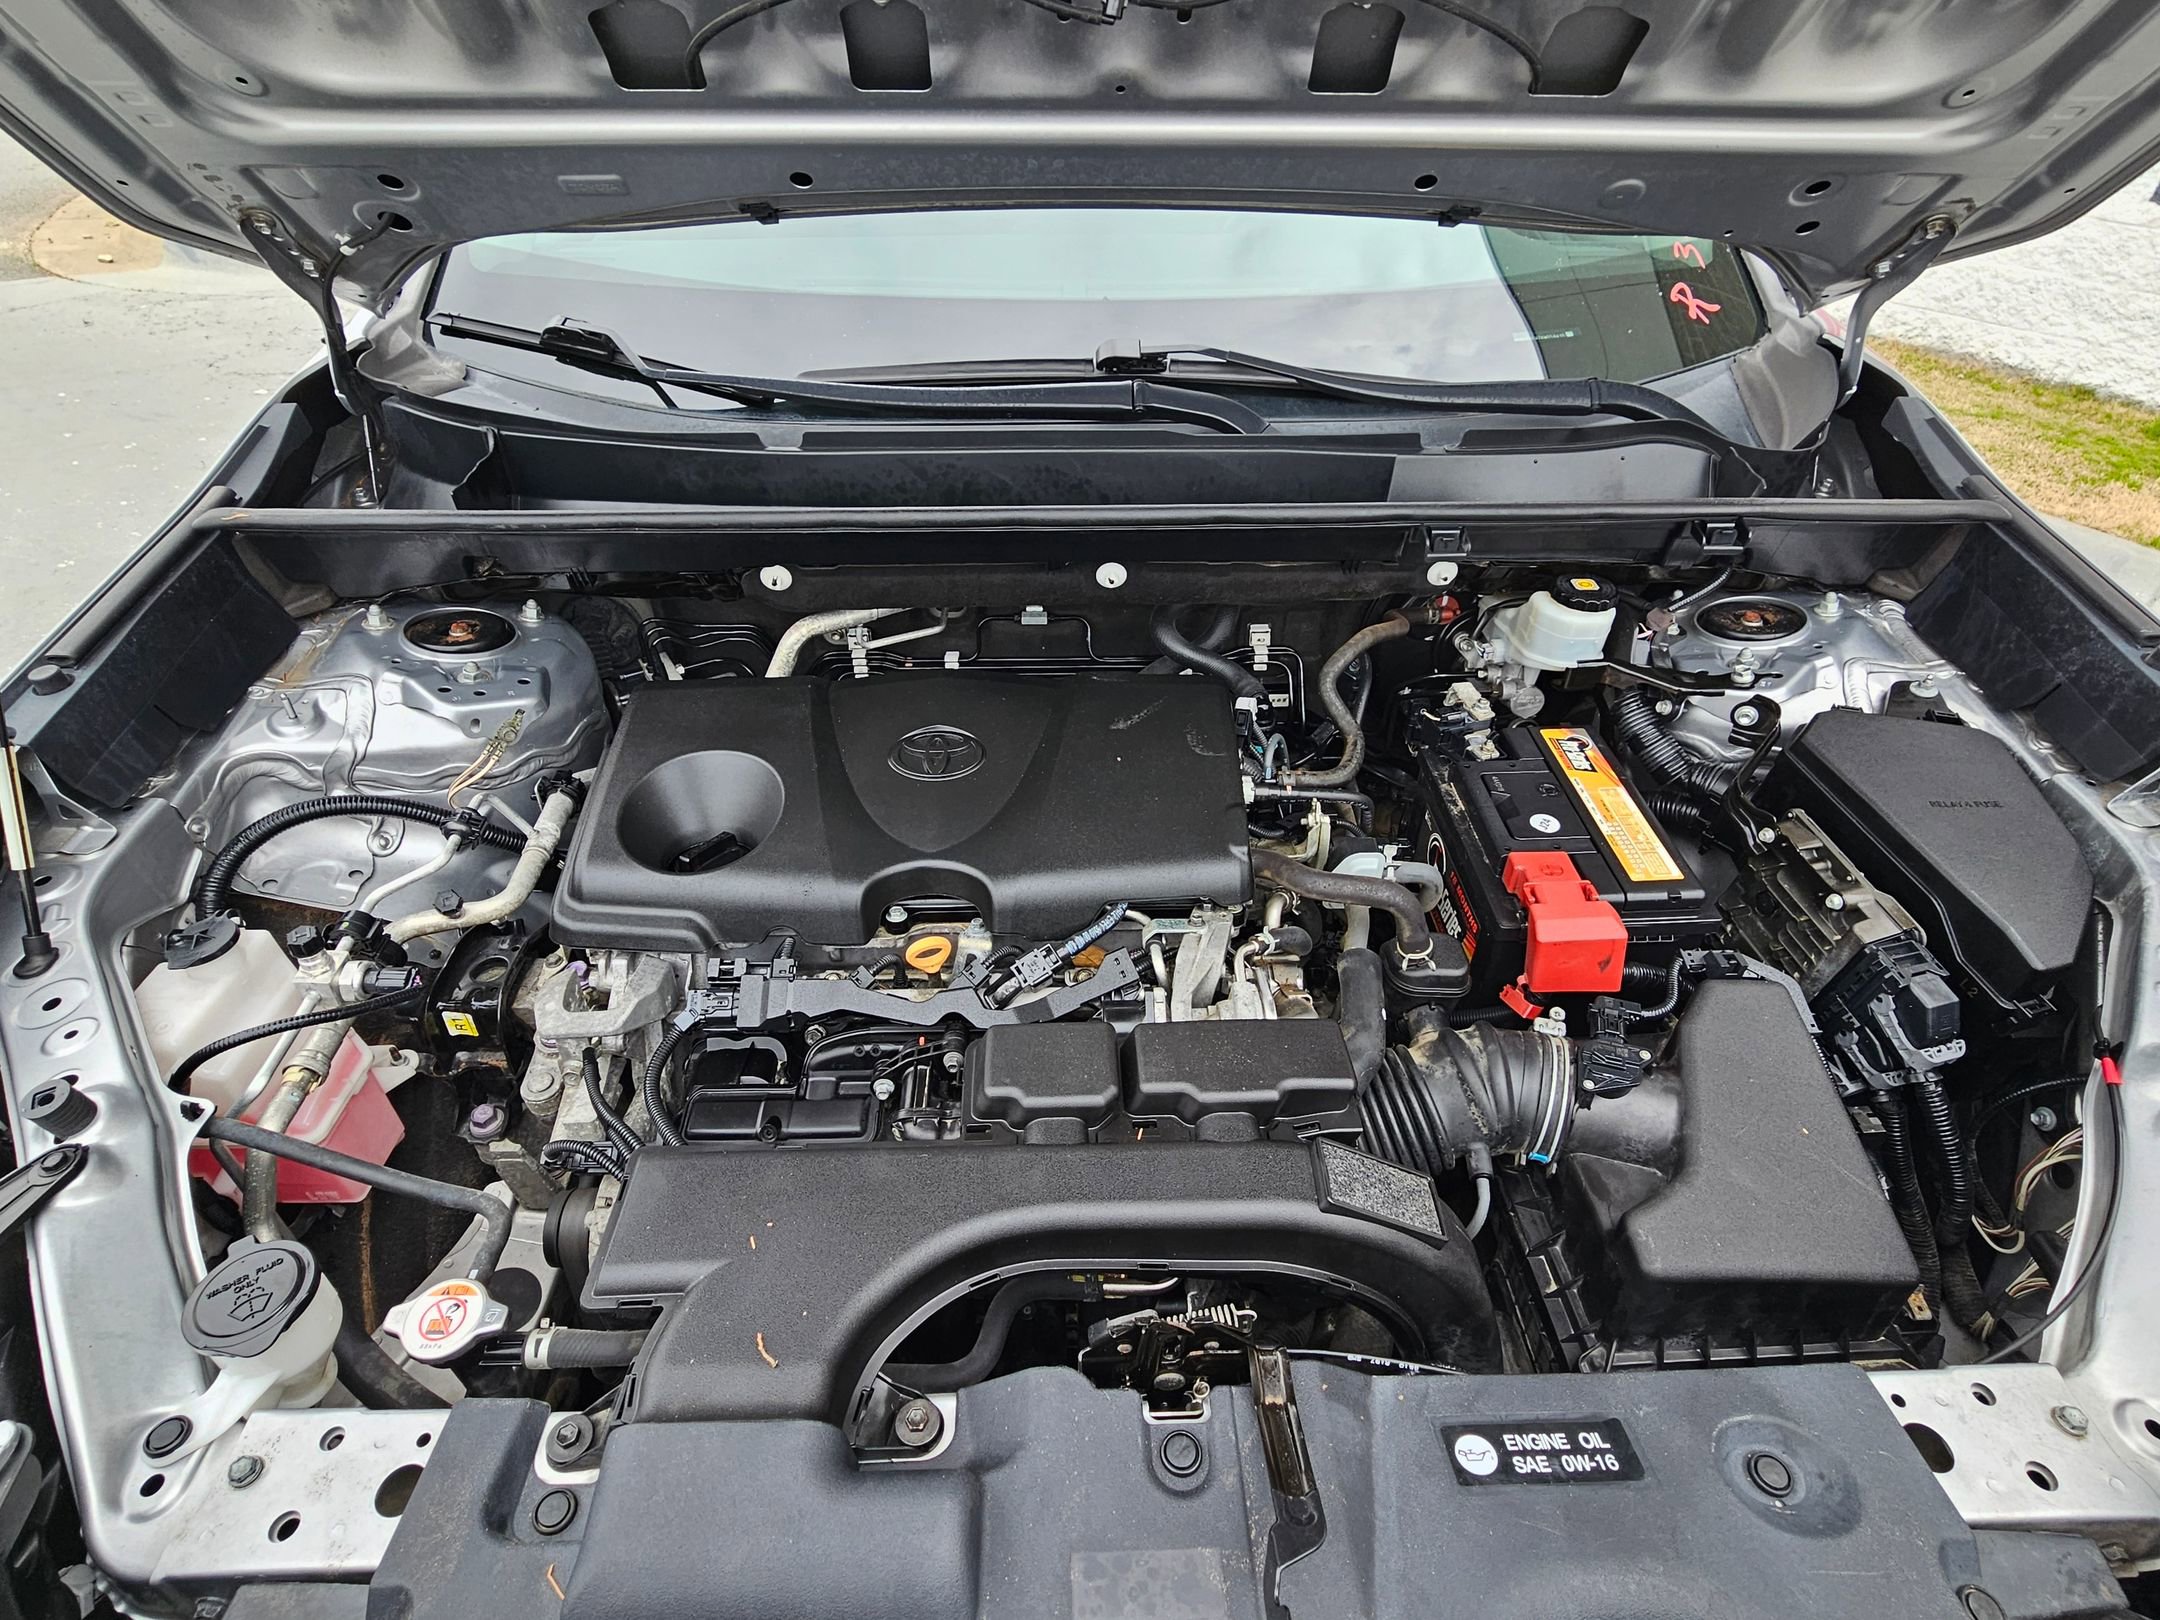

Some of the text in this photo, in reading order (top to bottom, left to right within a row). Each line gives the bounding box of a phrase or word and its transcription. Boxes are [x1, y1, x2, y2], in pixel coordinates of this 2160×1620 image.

[1928, 800, 1963, 808] RELAY
[1974, 800, 2004, 808] FUSE
[1456, 884, 1478, 934] MONTHS
[451, 1018, 469, 1031] R1
[206, 1257, 284, 1300] WASHER FLUID
[233, 1276, 260, 1294] ONLY
[1502, 1432, 1611, 1451] ENGINE OIL
[1512, 1454, 1620, 1474] SAE 0W-16
